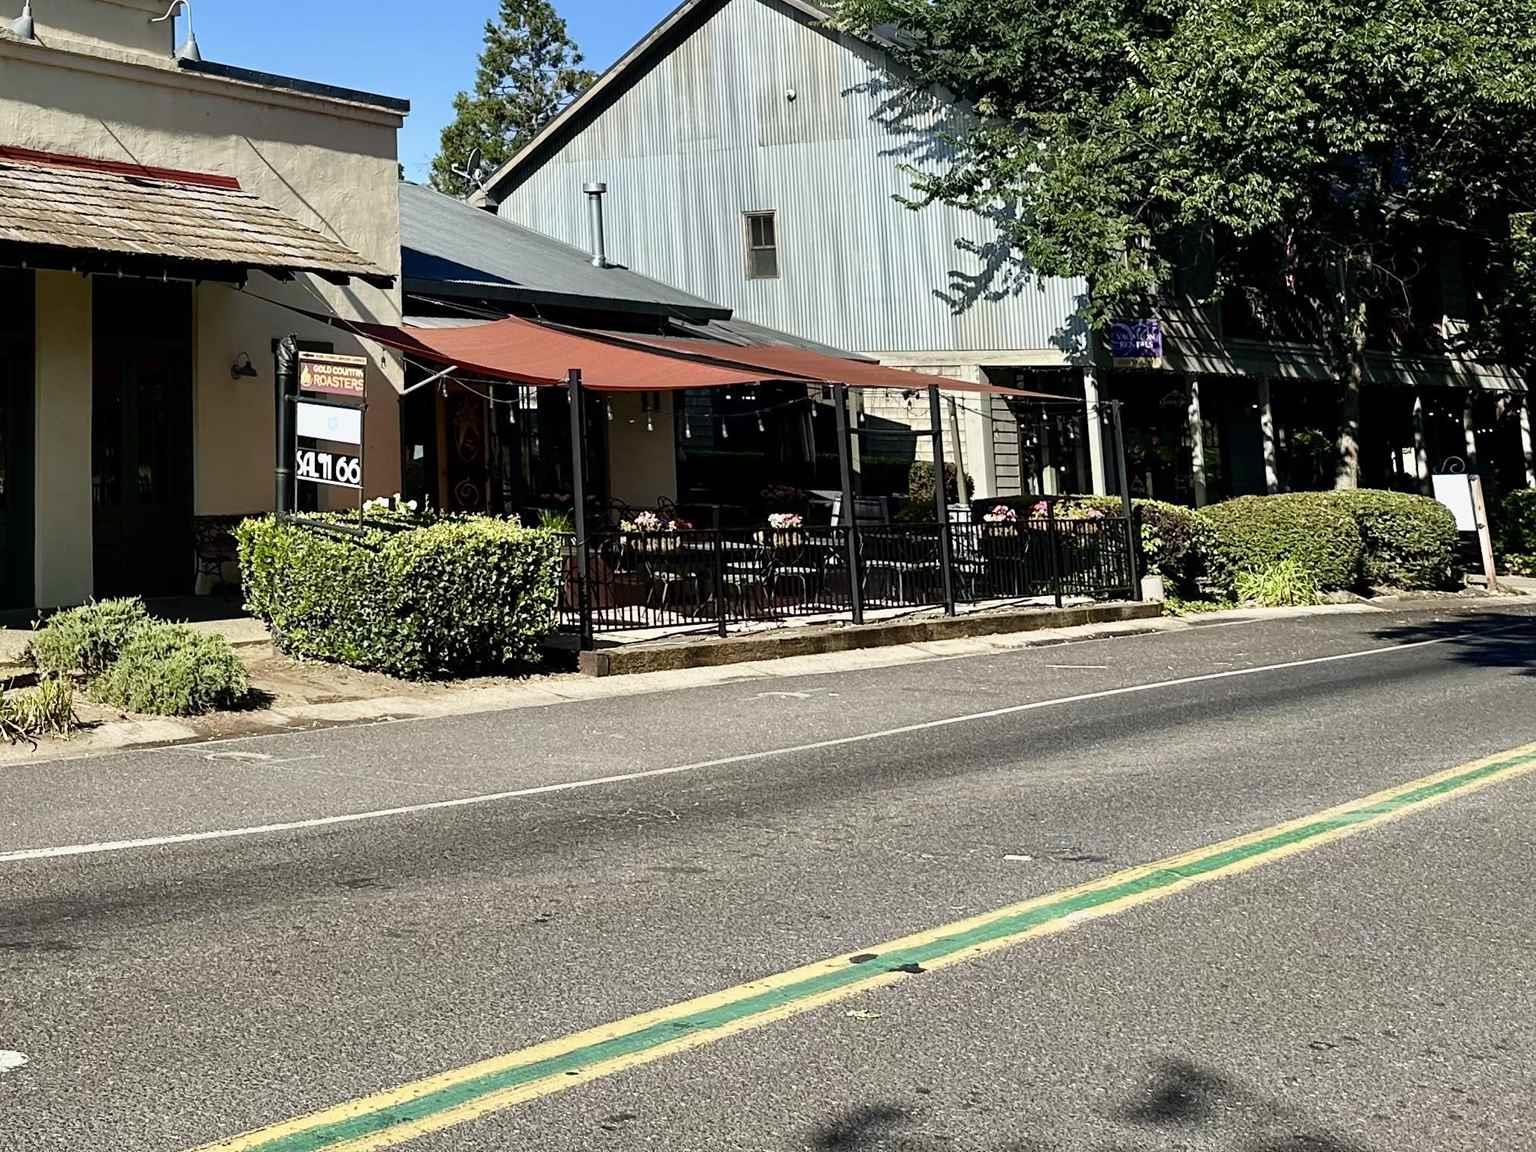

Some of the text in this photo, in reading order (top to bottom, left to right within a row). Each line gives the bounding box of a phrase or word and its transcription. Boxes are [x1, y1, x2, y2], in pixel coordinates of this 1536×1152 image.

[313, 364, 332, 373] GOLD
[313, 374, 364, 392] ROASTERS
[336, 456, 361, 484] 66
